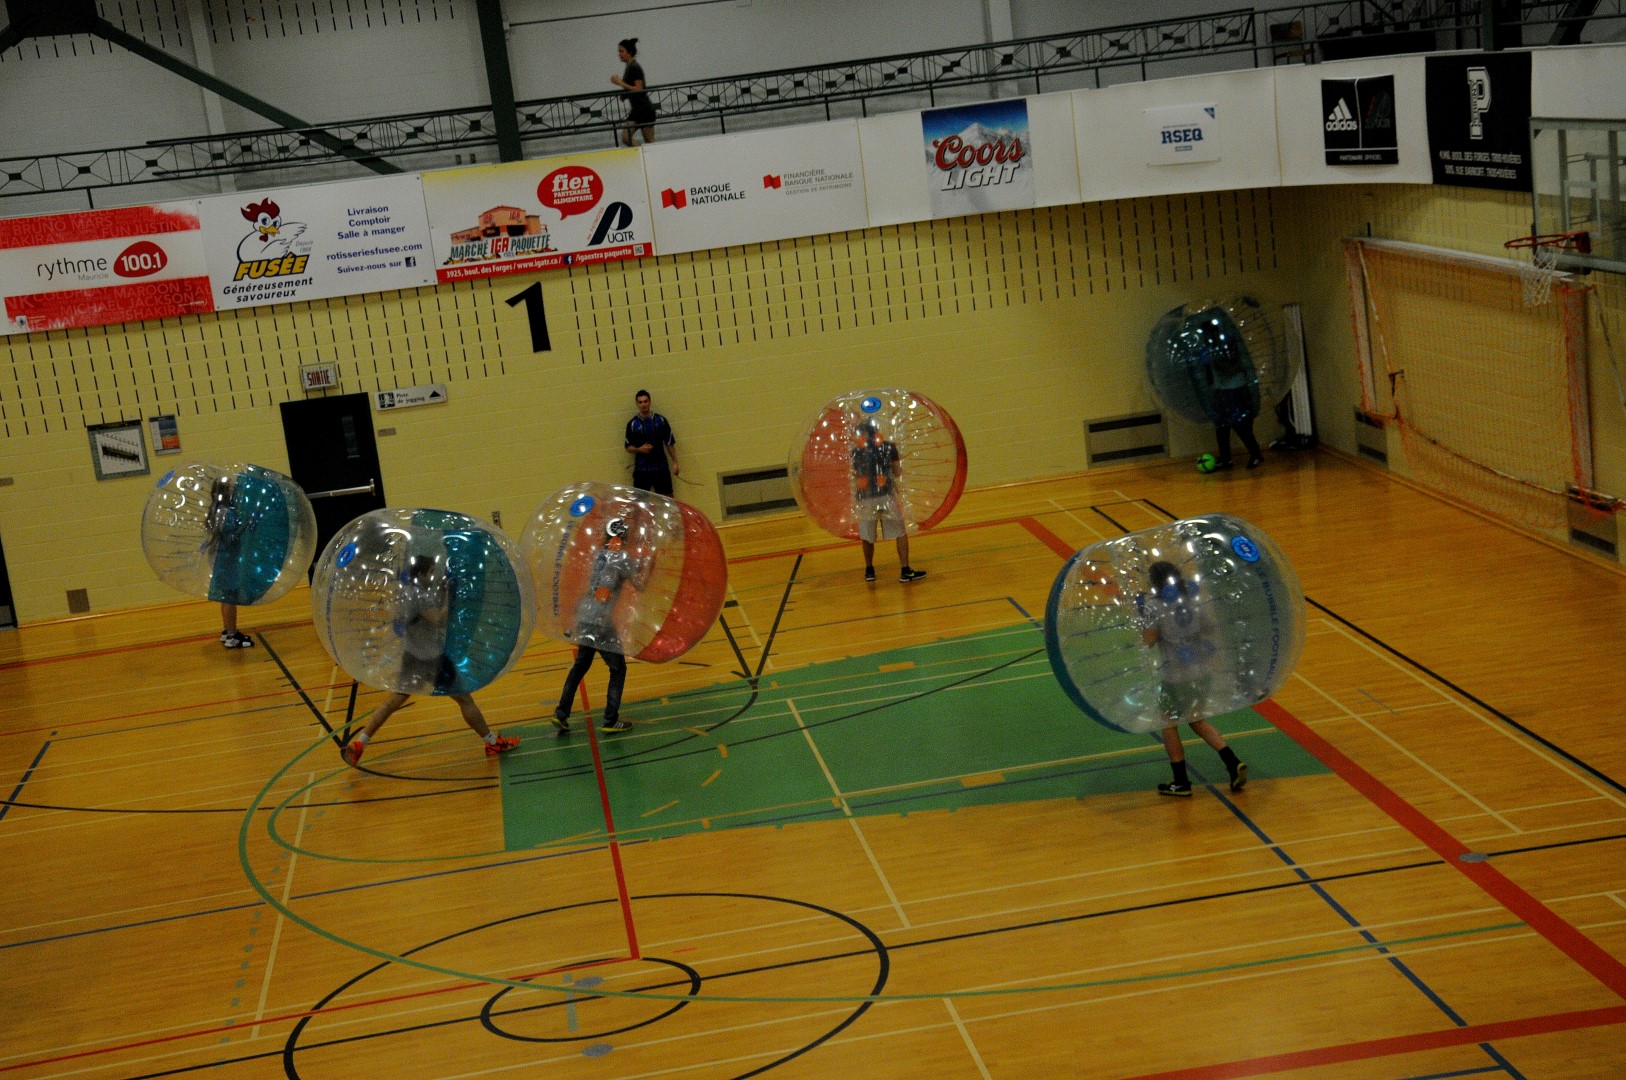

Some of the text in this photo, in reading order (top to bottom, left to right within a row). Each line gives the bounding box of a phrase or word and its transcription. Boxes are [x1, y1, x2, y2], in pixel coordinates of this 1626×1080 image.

[1466, 66, 1492, 140] P
[1325, 120, 1358, 132] adidas
[1161, 127, 1203, 144] RSEQ
[932, 134, 1026, 171] Coors
[783, 169, 825, 179] FINANCIÈRE
[784, 172, 854, 187] BANQUE NATIONALE
[941, 163, 1021, 191] LIGHT
[552, 173, 594, 193] fier
[690, 183, 731, 196] BANQUE
[553, 187, 591, 198] PARTENAIRE
[553, 194, 594, 205] ALIMENTAIRE
[691, 191, 746, 206] NATIONALE
[347, 205, 389, 216] Livraison
[13, 220, 67, 236] BRUNO
[71, 216, 114, 231] MARS
[348, 216, 391, 227] Comptoir
[337, 226, 406, 240] Salle à manger
[607, 231, 635, 244] UQTR
[326, 242, 423, 261] rotisseriesfusee.com
[450, 234, 551, 260] MARCHÉ IGA PAQUETTE
[37, 258, 108, 281] rythme
[121, 252, 163, 272] 100.1
[233, 251, 310, 281] FUSÉE
[337, 263, 387, 274] Suivez-nous
[389, 260, 402, 268] sur
[445, 269, 463, 279] 3925,
[464, 267, 480, 277] boul.
[480, 266, 492, 275] des
[492, 263, 513, 275] Forges
[604, 248, 633, 260] paquette
[114, 282, 180, 299] MAROON
[223, 276, 313, 295] Généreusement
[236, 289, 297, 303] savoureux
[504, 281, 552, 353] 1
[306, 369, 331, 387] SORTIE
